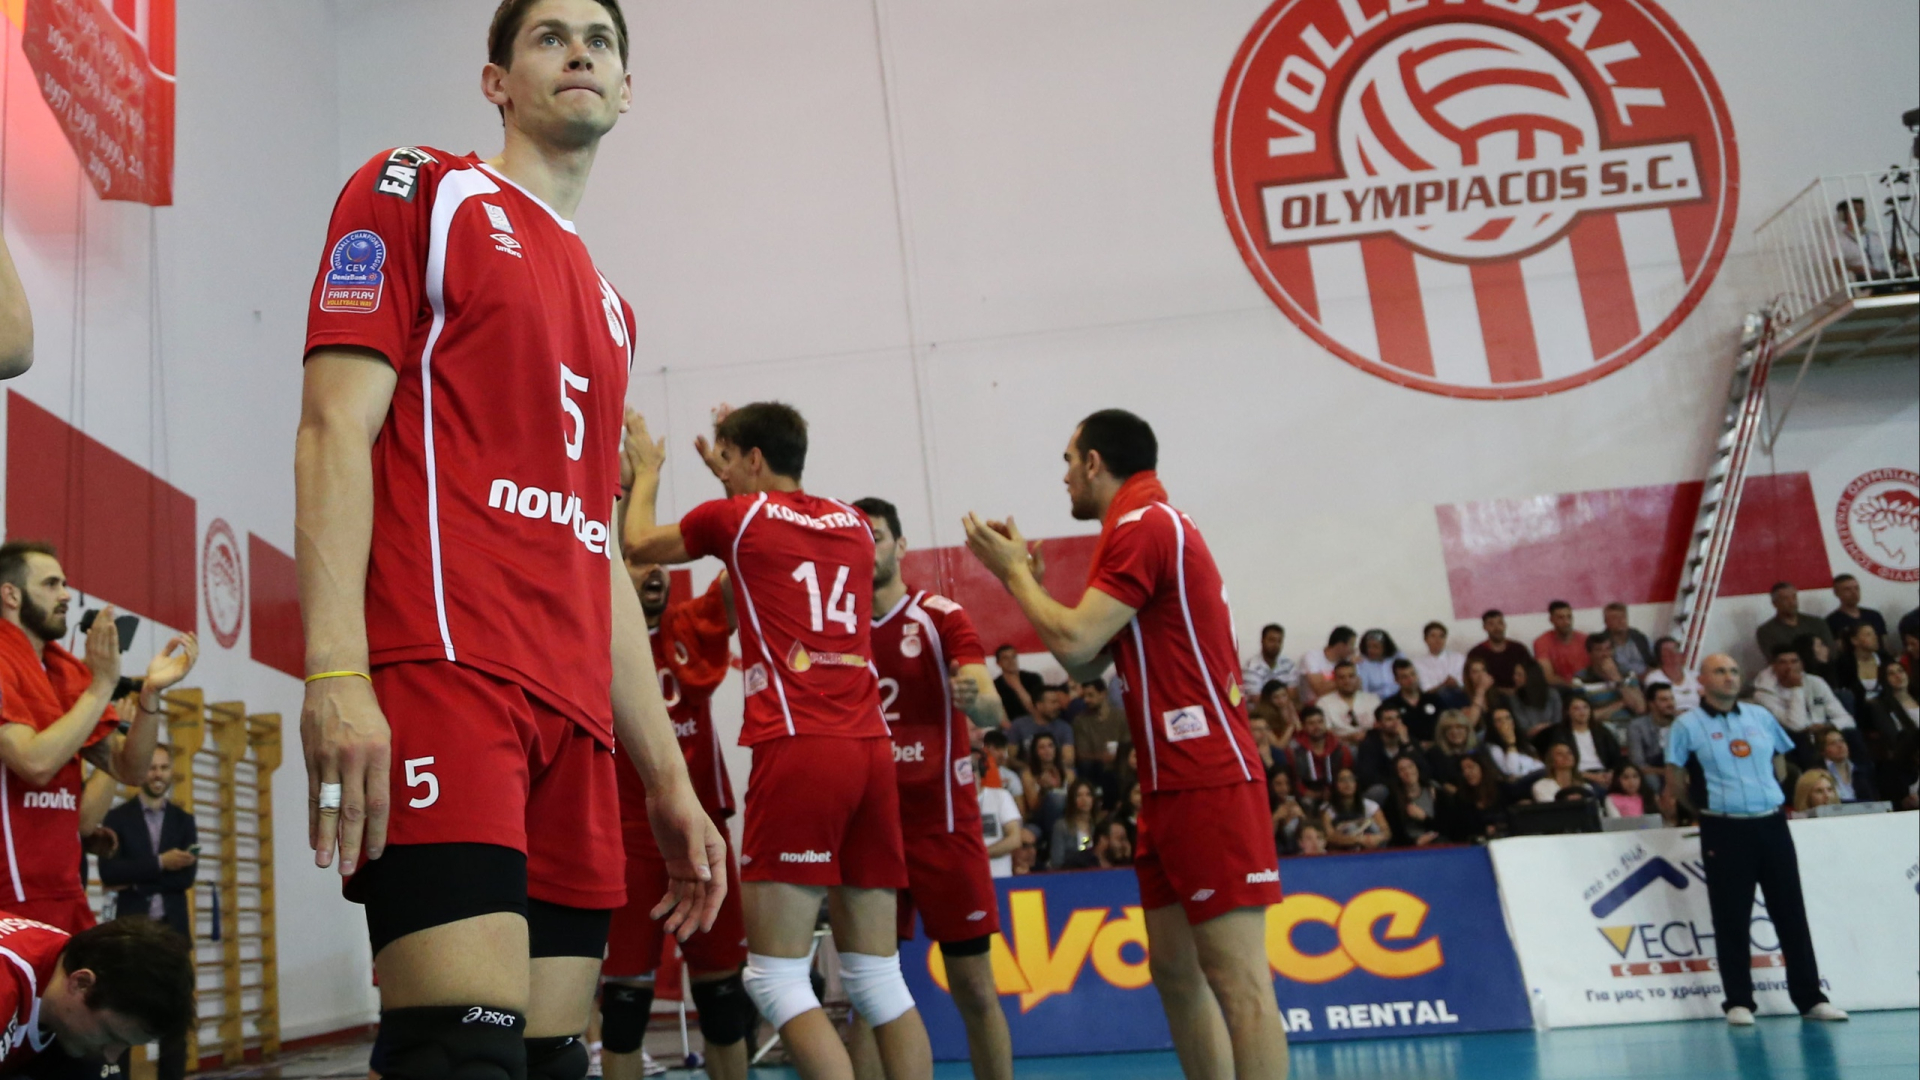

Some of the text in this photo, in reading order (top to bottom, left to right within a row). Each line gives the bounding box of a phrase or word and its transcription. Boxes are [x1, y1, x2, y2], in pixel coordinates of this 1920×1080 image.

[1267, 0, 1666, 157] VOLLALL
[1281, 155, 1687, 230] OLYMPIACOS S.C.
[494, 244, 523, 258] umbro
[332, 273, 367, 281] DenizBank
[345, 263, 367, 272] CEV
[328, 290, 375, 300] FAIR PLAY
[559, 362, 590, 461] 5
[487, 478, 611, 560] novbe
[791, 560, 858, 635] 14
[404, 755, 440, 809] 5
[779, 849, 833, 863] novibet
[1597, 915, 1781, 960] VECHO
[1619, 953, 1782, 977] COLOS
[1585, 988, 1610, 1002] Για
[1614, 987, 1645, 1004] μας
[1646, 986, 1666, 998] το
[1670, 981, 1721, 1000] χρώμα
[480, 1010, 516, 1027] asics
[1325, 999, 1460, 1031] RENTAL
